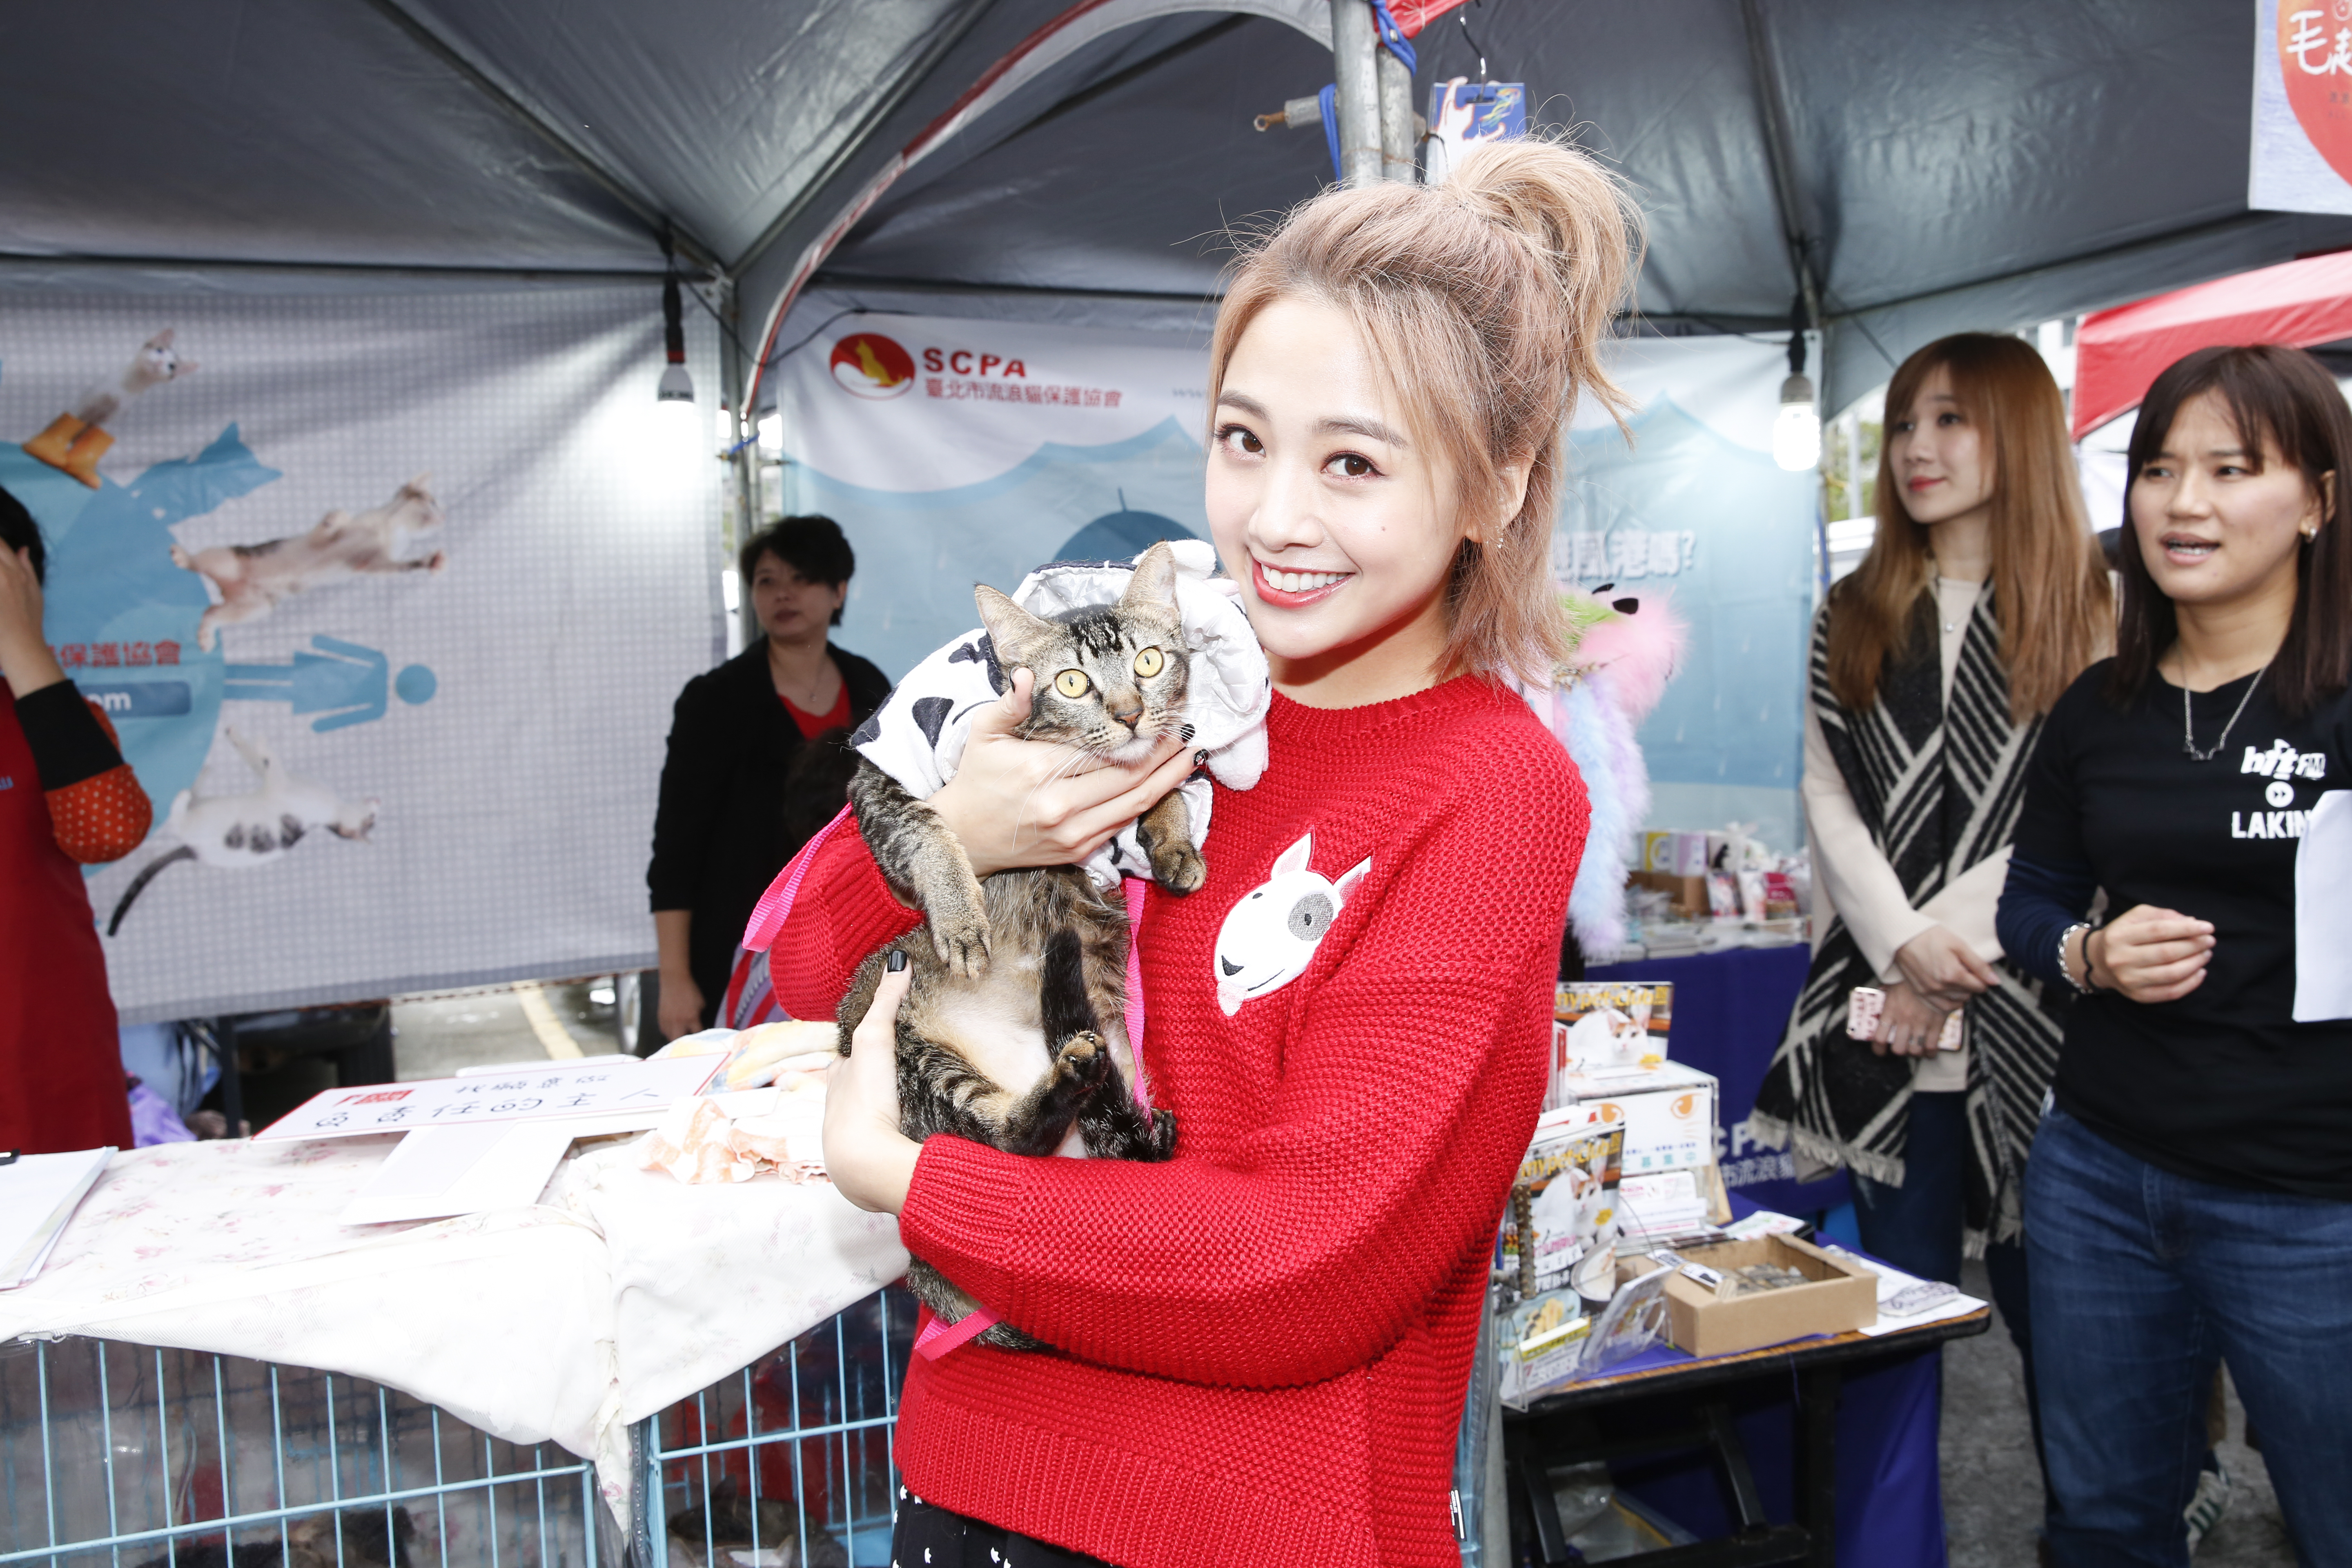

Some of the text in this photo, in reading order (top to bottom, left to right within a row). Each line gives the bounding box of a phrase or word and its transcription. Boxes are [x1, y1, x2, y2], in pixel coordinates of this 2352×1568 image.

[923, 347, 1027, 378] SCPA
[48, 639, 181, 669] 保護協會
